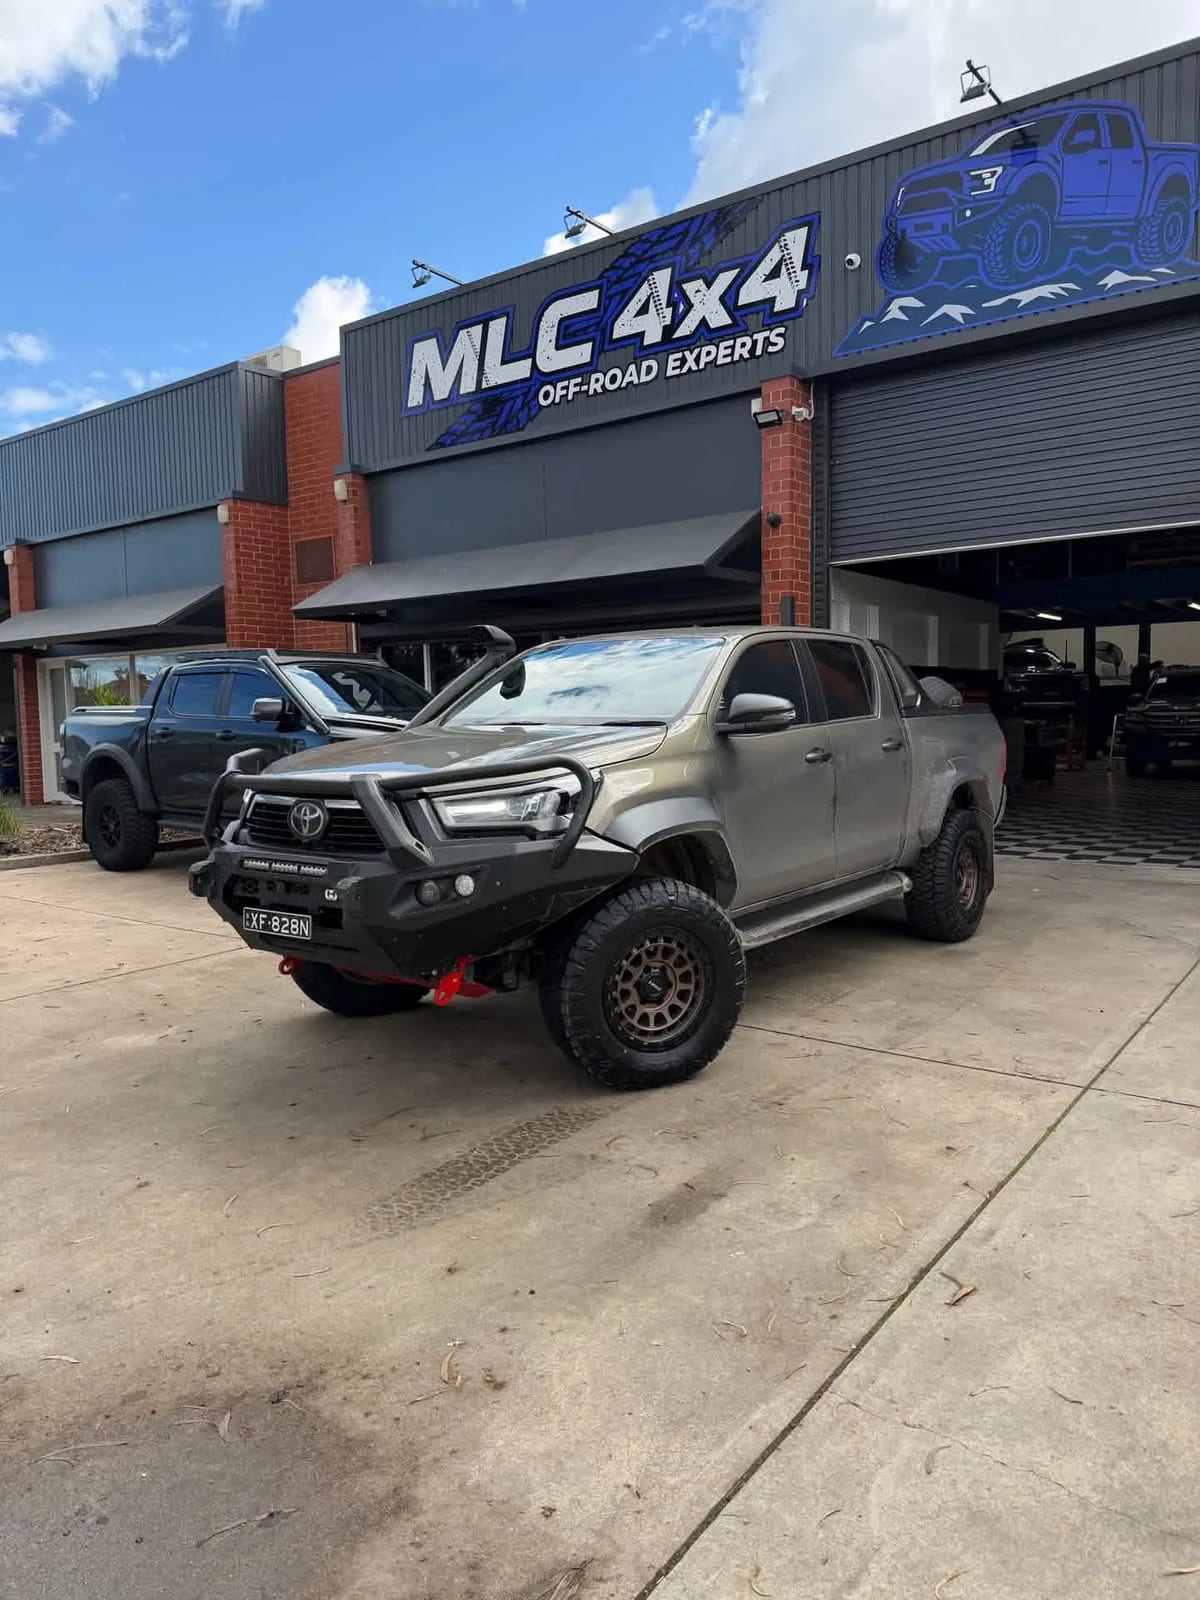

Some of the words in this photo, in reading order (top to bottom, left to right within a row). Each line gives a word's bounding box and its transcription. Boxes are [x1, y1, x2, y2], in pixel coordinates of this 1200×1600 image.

[407, 289, 600, 408] MLC
[612, 226, 809, 346] 4x4
[538, 359, 658, 407] OFF-ROAD
[666, 327, 786, 377] EXPERTS
